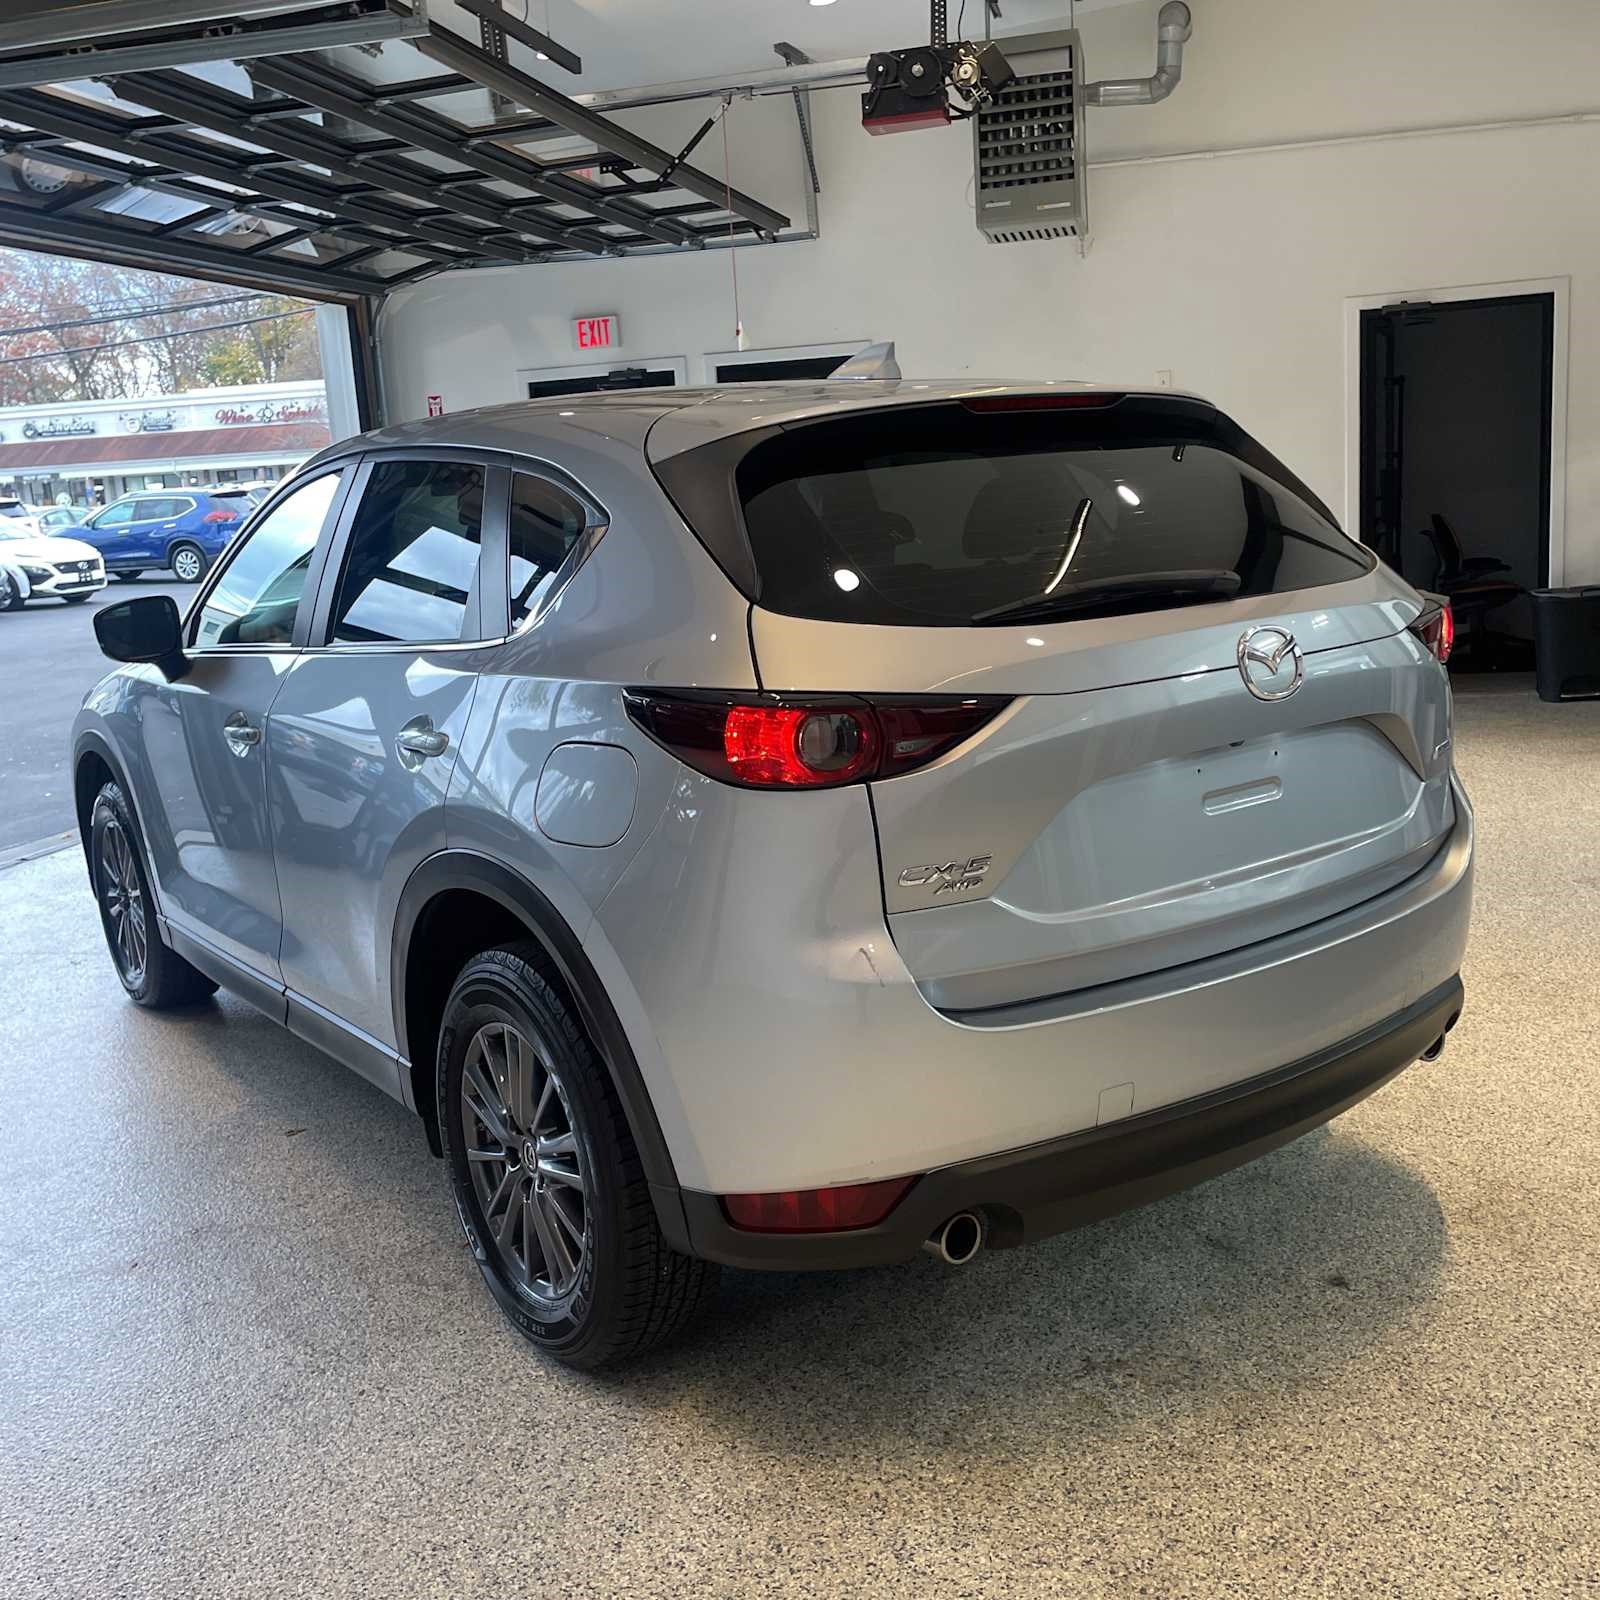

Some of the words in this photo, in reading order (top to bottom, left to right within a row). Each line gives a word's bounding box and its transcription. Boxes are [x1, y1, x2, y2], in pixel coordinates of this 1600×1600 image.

[577, 319, 609, 348] EXIT
[898, 854, 992, 887] CX-5
[933, 878, 983, 895] AWD
